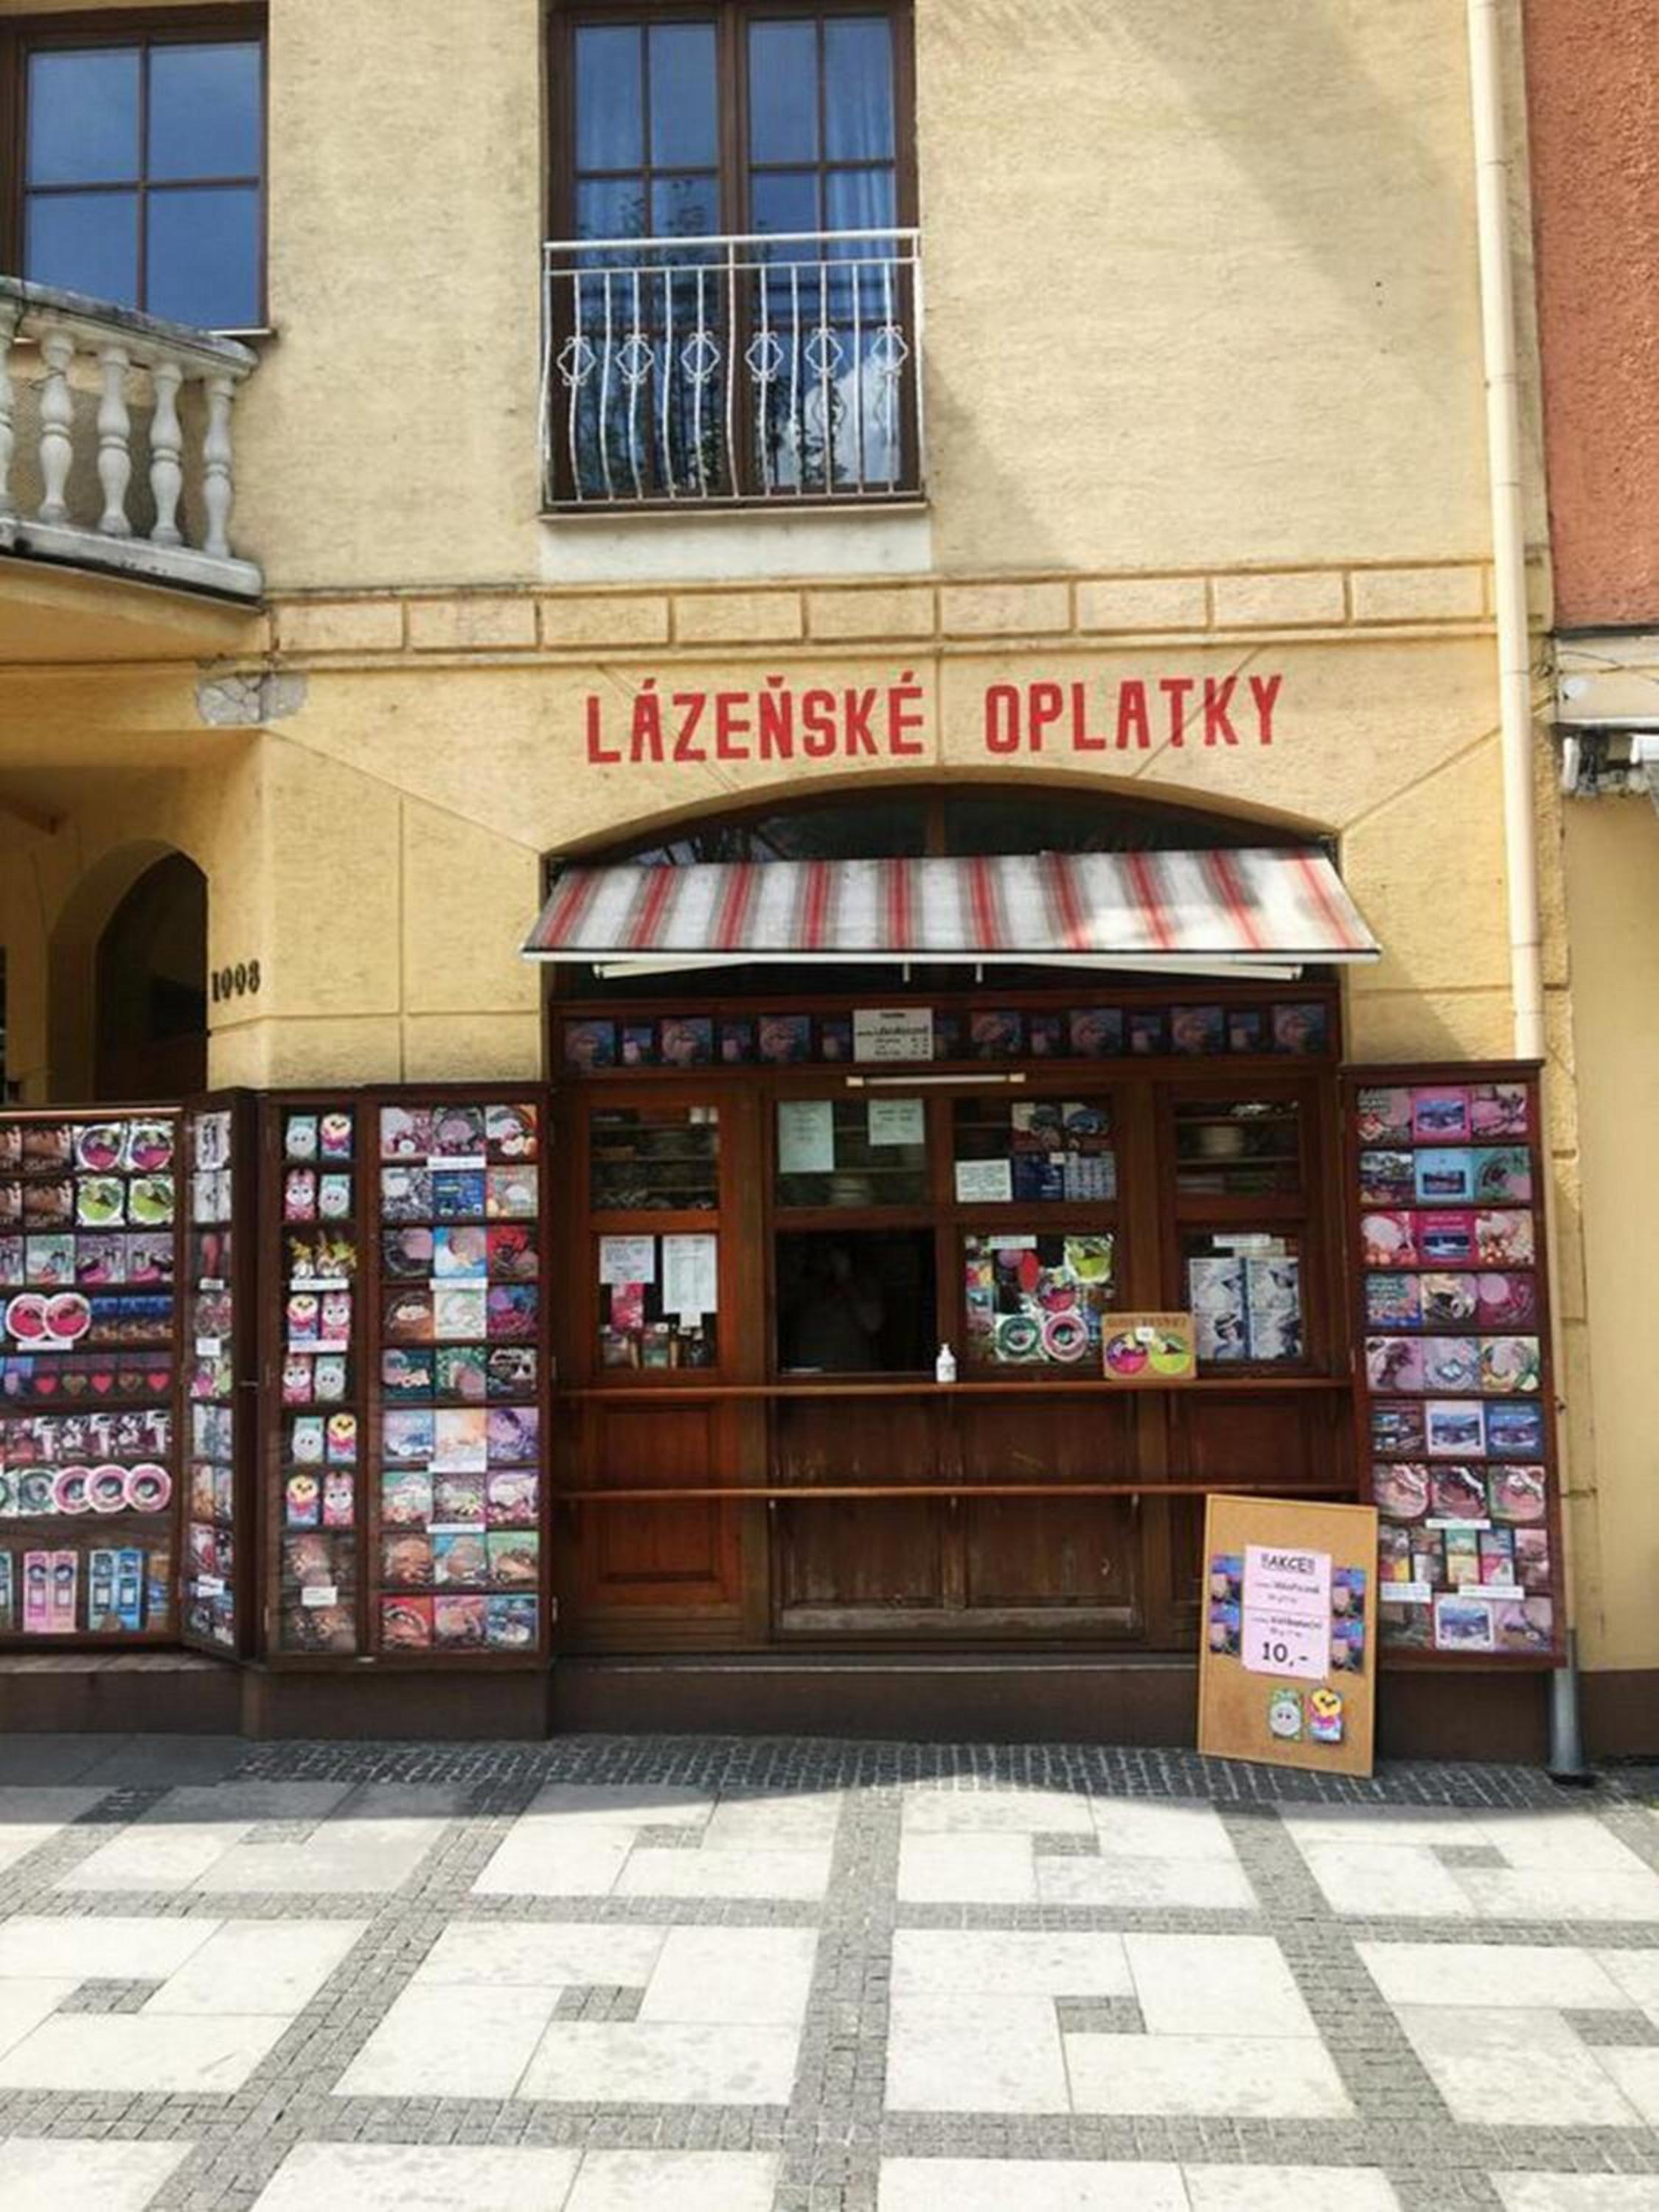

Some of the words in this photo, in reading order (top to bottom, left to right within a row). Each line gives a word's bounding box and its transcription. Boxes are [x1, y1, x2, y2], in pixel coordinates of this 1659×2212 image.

[587, 670, 924, 763] LÁZEŇSKÉ
[985, 675, 1282, 754] OPLATKY
[212, 959, 260, 1002] 1008
[1262, 1641, 1309, 1667] 10,-
